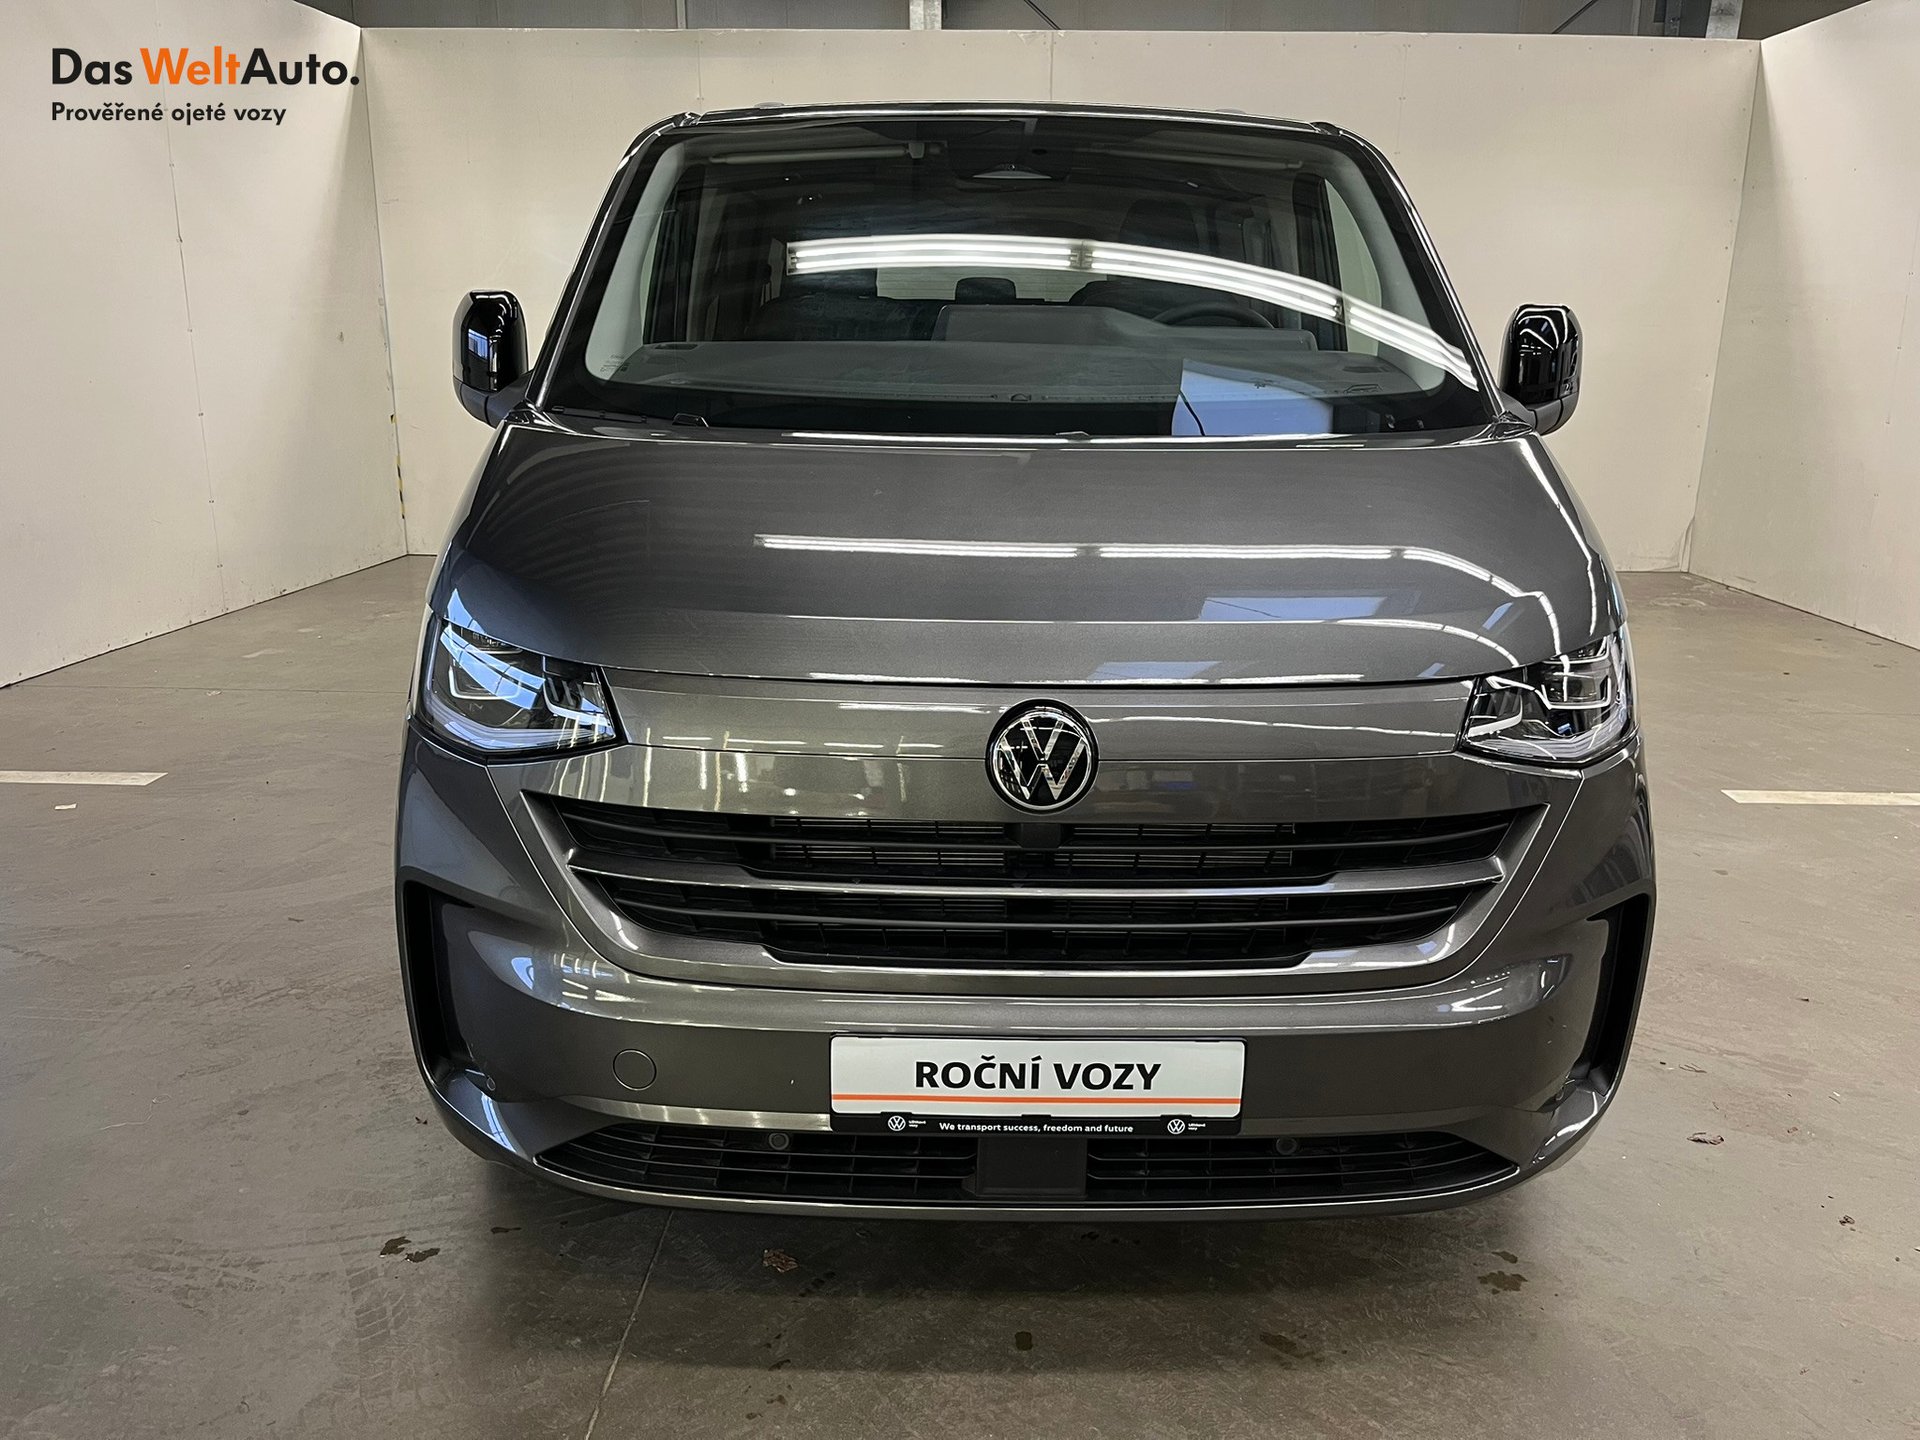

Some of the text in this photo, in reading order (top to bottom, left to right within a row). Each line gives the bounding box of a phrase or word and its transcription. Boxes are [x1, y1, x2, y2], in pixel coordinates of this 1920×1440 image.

[916, 1055, 1162, 1091] ROČNÍ VOZY
[939, 1122, 1134, 1133] We transport success, freedom and future
